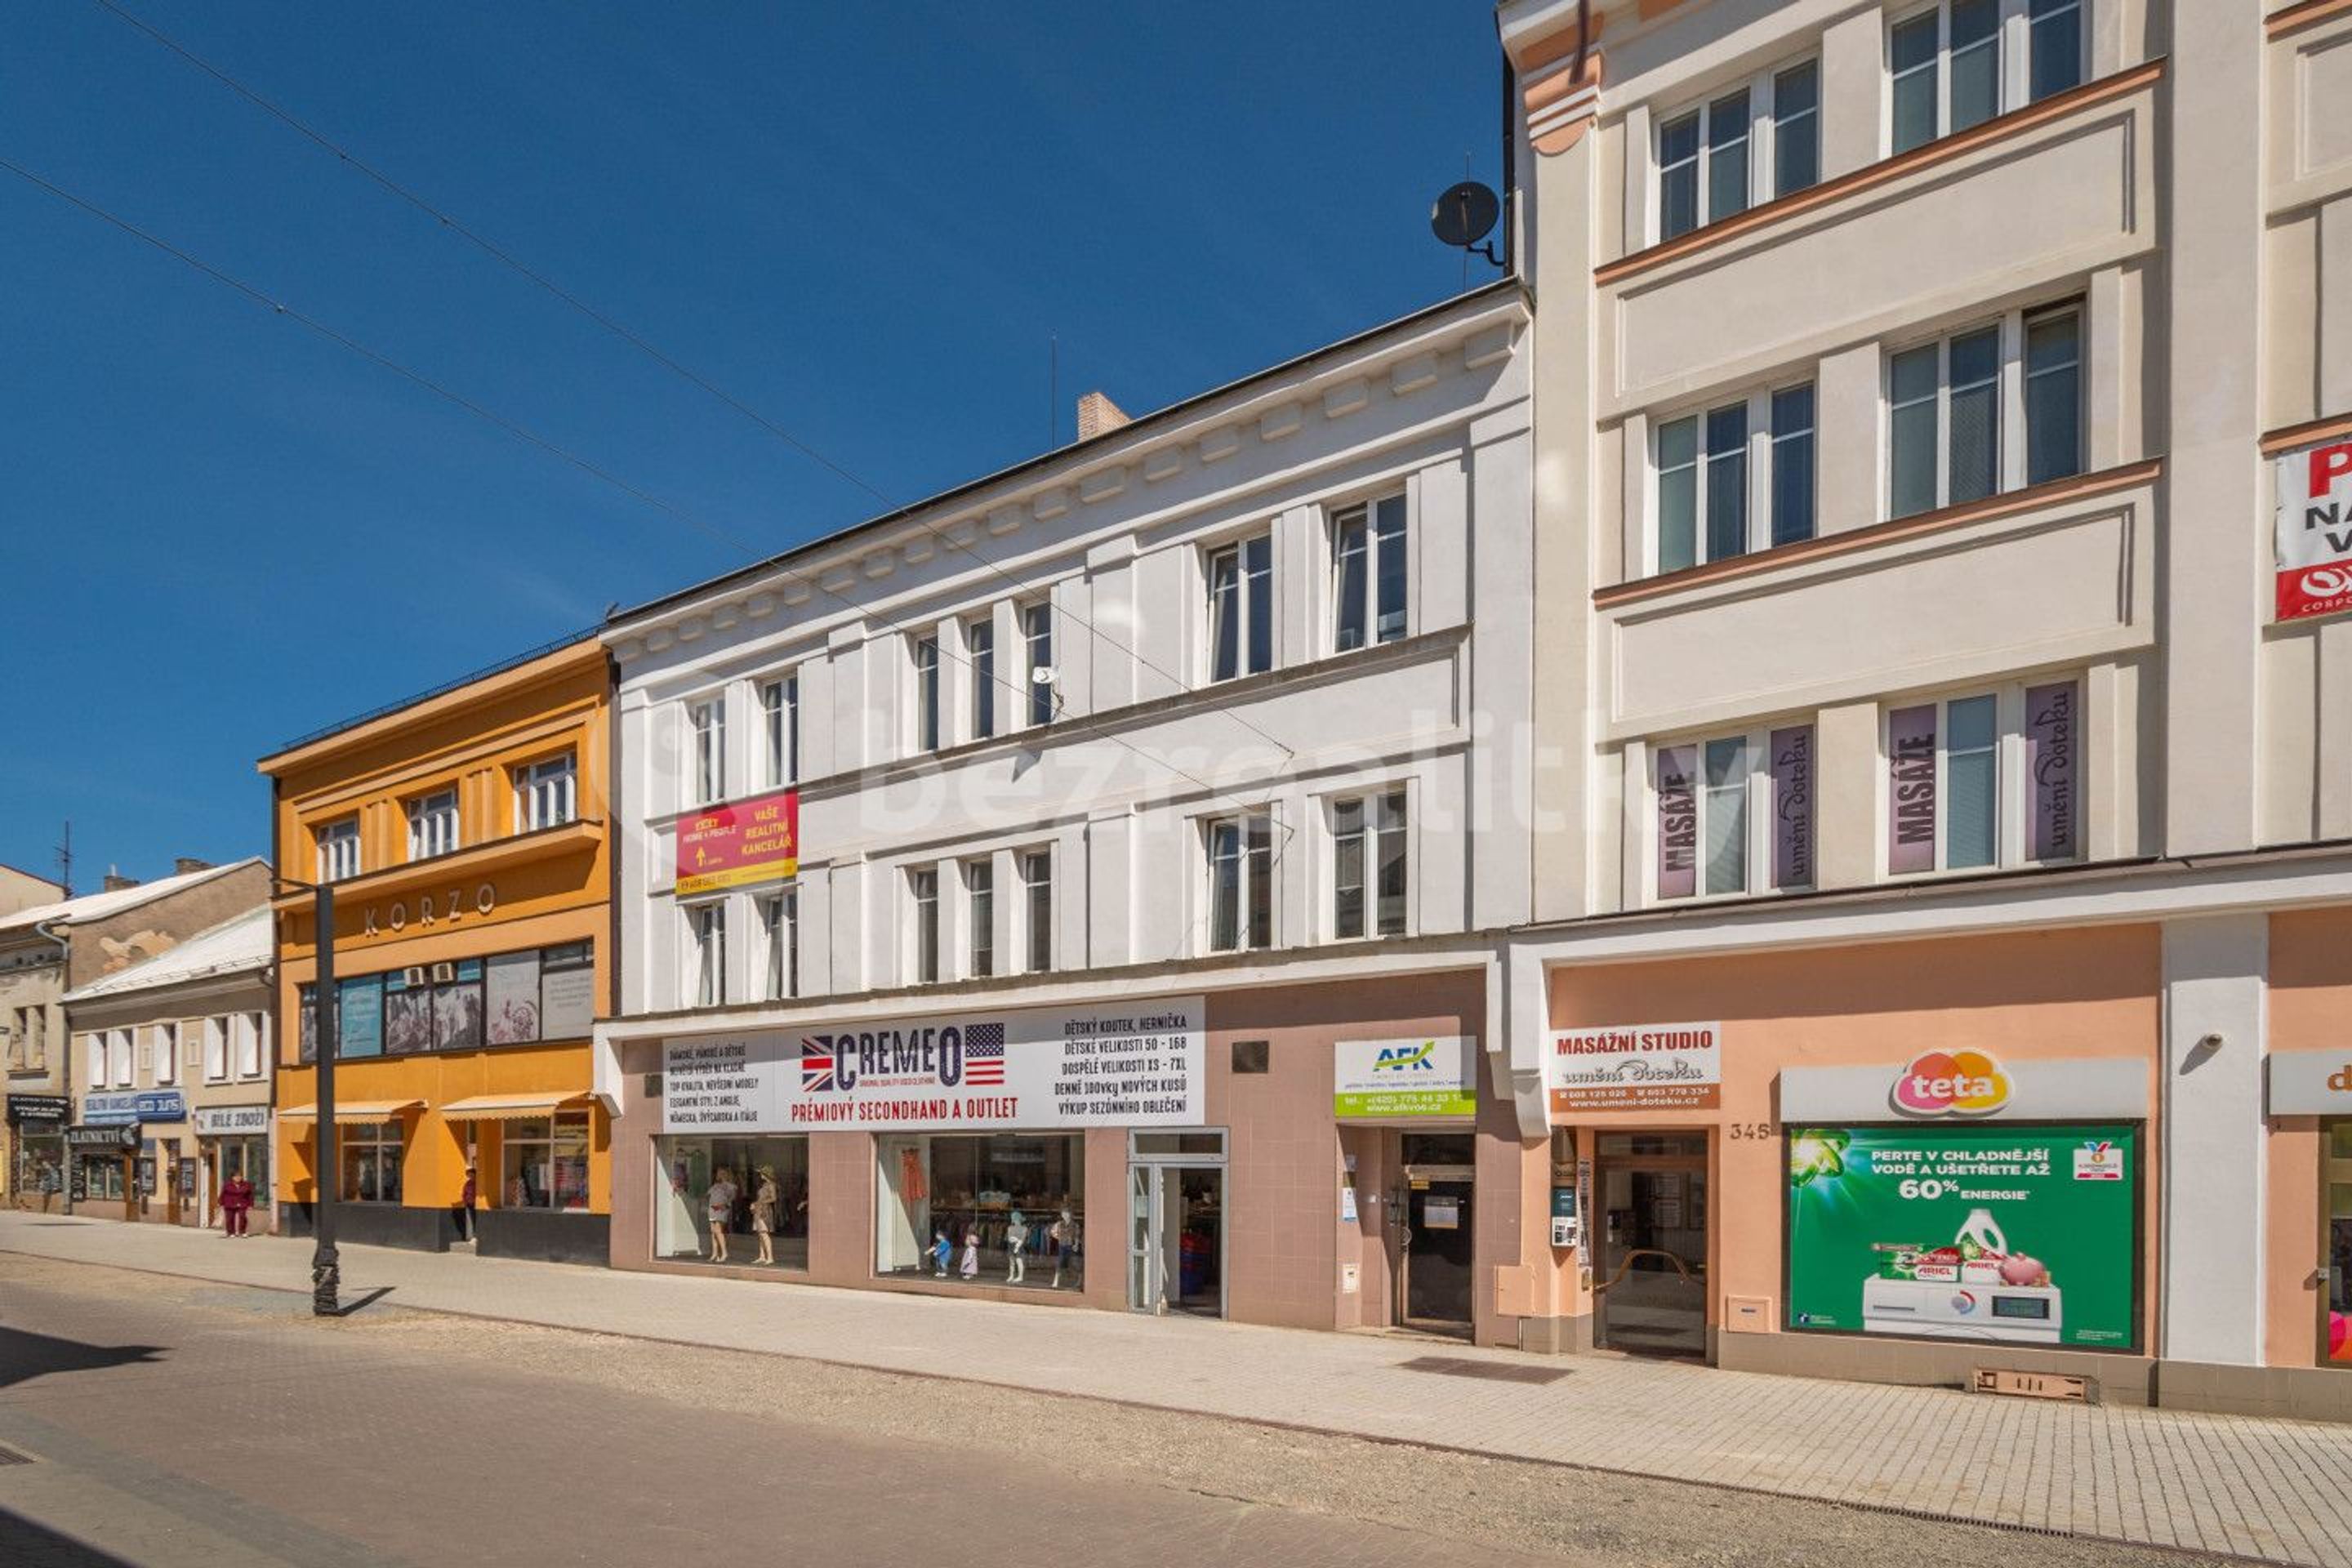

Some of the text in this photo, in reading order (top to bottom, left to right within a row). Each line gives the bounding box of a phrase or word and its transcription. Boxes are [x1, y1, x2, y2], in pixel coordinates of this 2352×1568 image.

[2305, 502, 2352, 529] N
[1891, 733, 1935, 844] MASÁŽE
[754, 804, 778, 822] VAŠE
[1659, 773, 1696, 871] MASÁŽE
[746, 817, 789, 840] REALITNÍ
[741, 834, 792, 856] KANCELÁŘ
[365, 883, 497, 937] KORZO
[1065, 1013, 1187, 1035] DĚTSKÝ KOUTEK, HERNIČKA
[1065, 1038, 1096, 1055] DĚTSKÉ
[1099, 1039, 1143, 1054] VELIKOSTI
[1145, 1037, 1157, 1051] 50
[1169, 1036, 1187, 1050] 168
[1557, 1031, 1713, 1054] MASÁŽNÍ STUDIO
[836, 1026, 962, 1091] CREMEO
[1062, 1058, 1098, 1075] DOSPĚLÉ
[1102, 1059, 1144, 1073] VELIKOSTI
[1148, 1058, 1160, 1071] XS
[1170, 1058, 1187, 1071] 7XL
[1373, 1045, 1435, 1072] AFK
[1562, 1058, 1704, 1085] umění doteku
[1055, 1080, 1081, 1095] DENNĚ
[1121, 1076, 1157, 1093] NOVÝCH
[1161, 1075, 1187, 1091] KUSŮ
[1912, 1074, 1995, 1098] teta
[791, 1096, 1018, 1122] PRÉMIOVÝ SECONDHAND A OUTLET
[1059, 1096, 1187, 1115] VÝKUP SEZÓNNÍHO OBLEČENÍ
[1569, 1097, 1699, 1107] www.umeni-doteku.cz
[1729, 1124, 1771, 1140] 345
[1872, 1148, 2050, 1160] PERTE V CHLADNĚJŠÍ
[1872, 1163, 2051, 1175] VODĚ A UŠETŘETE AŽ
[1899, 1179, 1959, 1200] 60%
[1918, 1266, 1953, 1276] ARIEL
